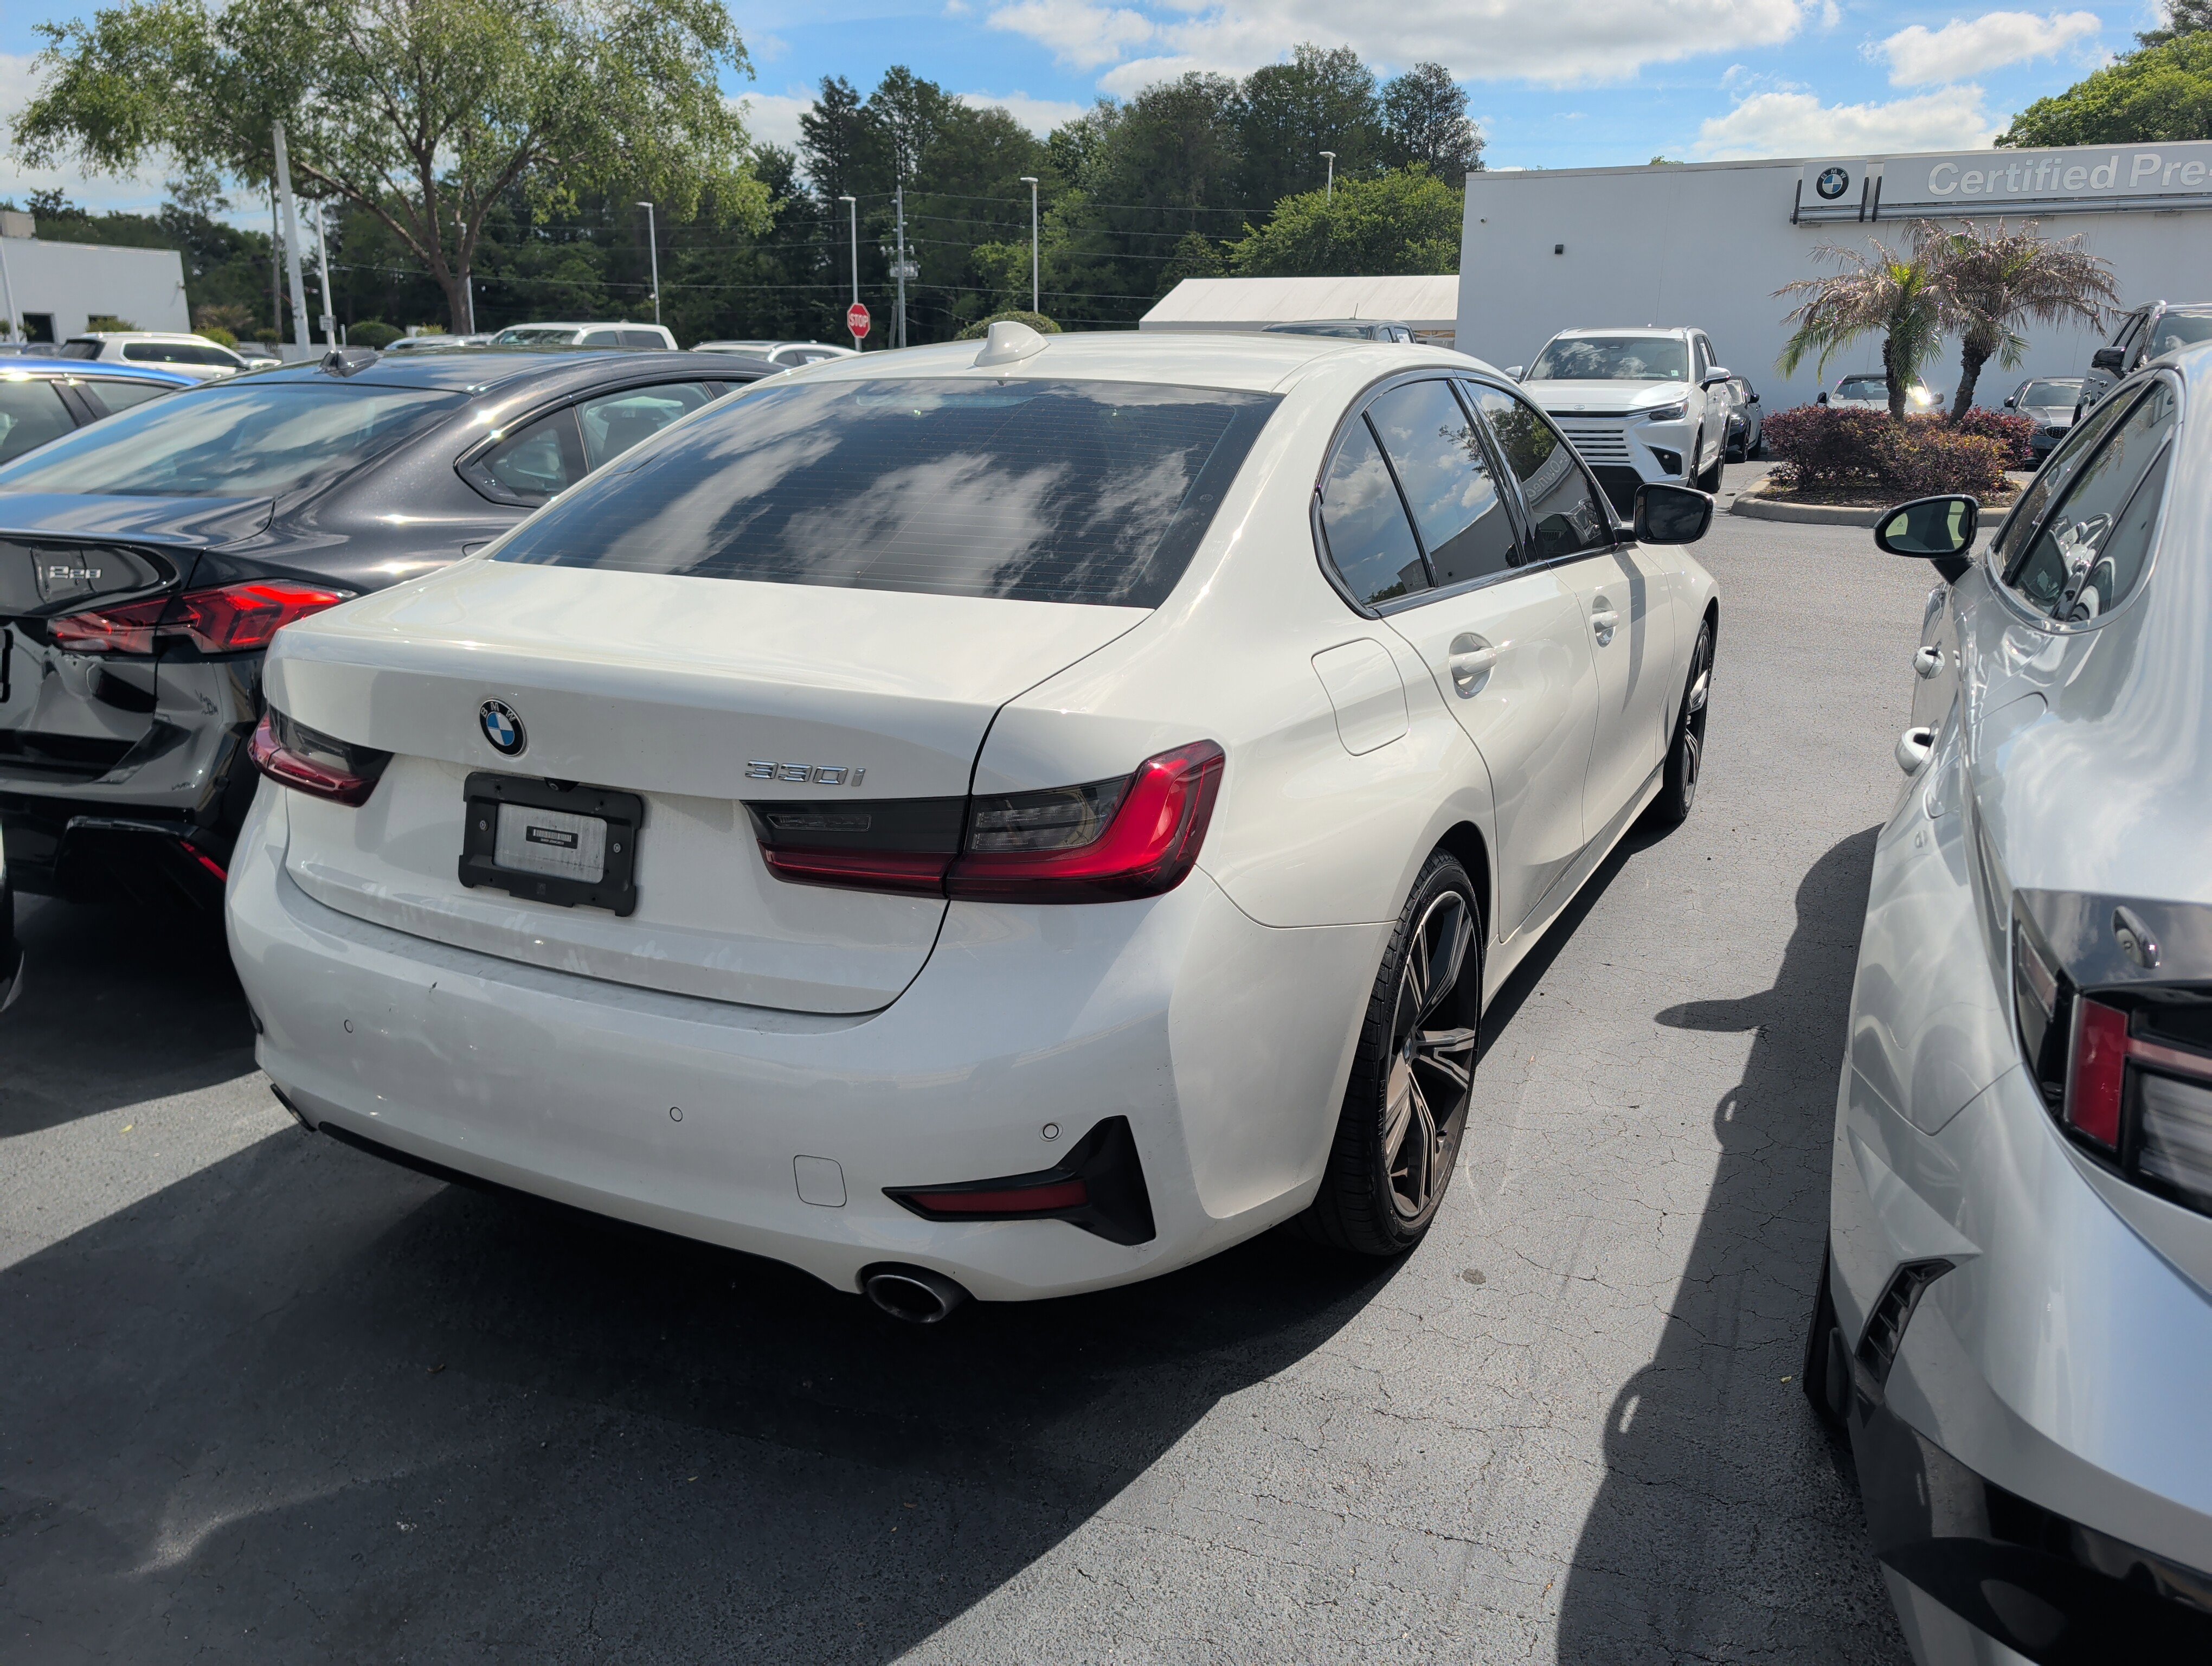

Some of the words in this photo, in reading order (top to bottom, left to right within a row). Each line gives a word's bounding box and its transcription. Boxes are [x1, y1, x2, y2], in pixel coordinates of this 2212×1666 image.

[1821, 169, 1847, 180] BMW
[1927, 155, 2119, 196] Certified
[2129, 153, 2212, 188] Pre
[849, 313, 869, 328] STOP
[480, 701, 516, 722] BMW
[744, 760, 866, 787] 330i
